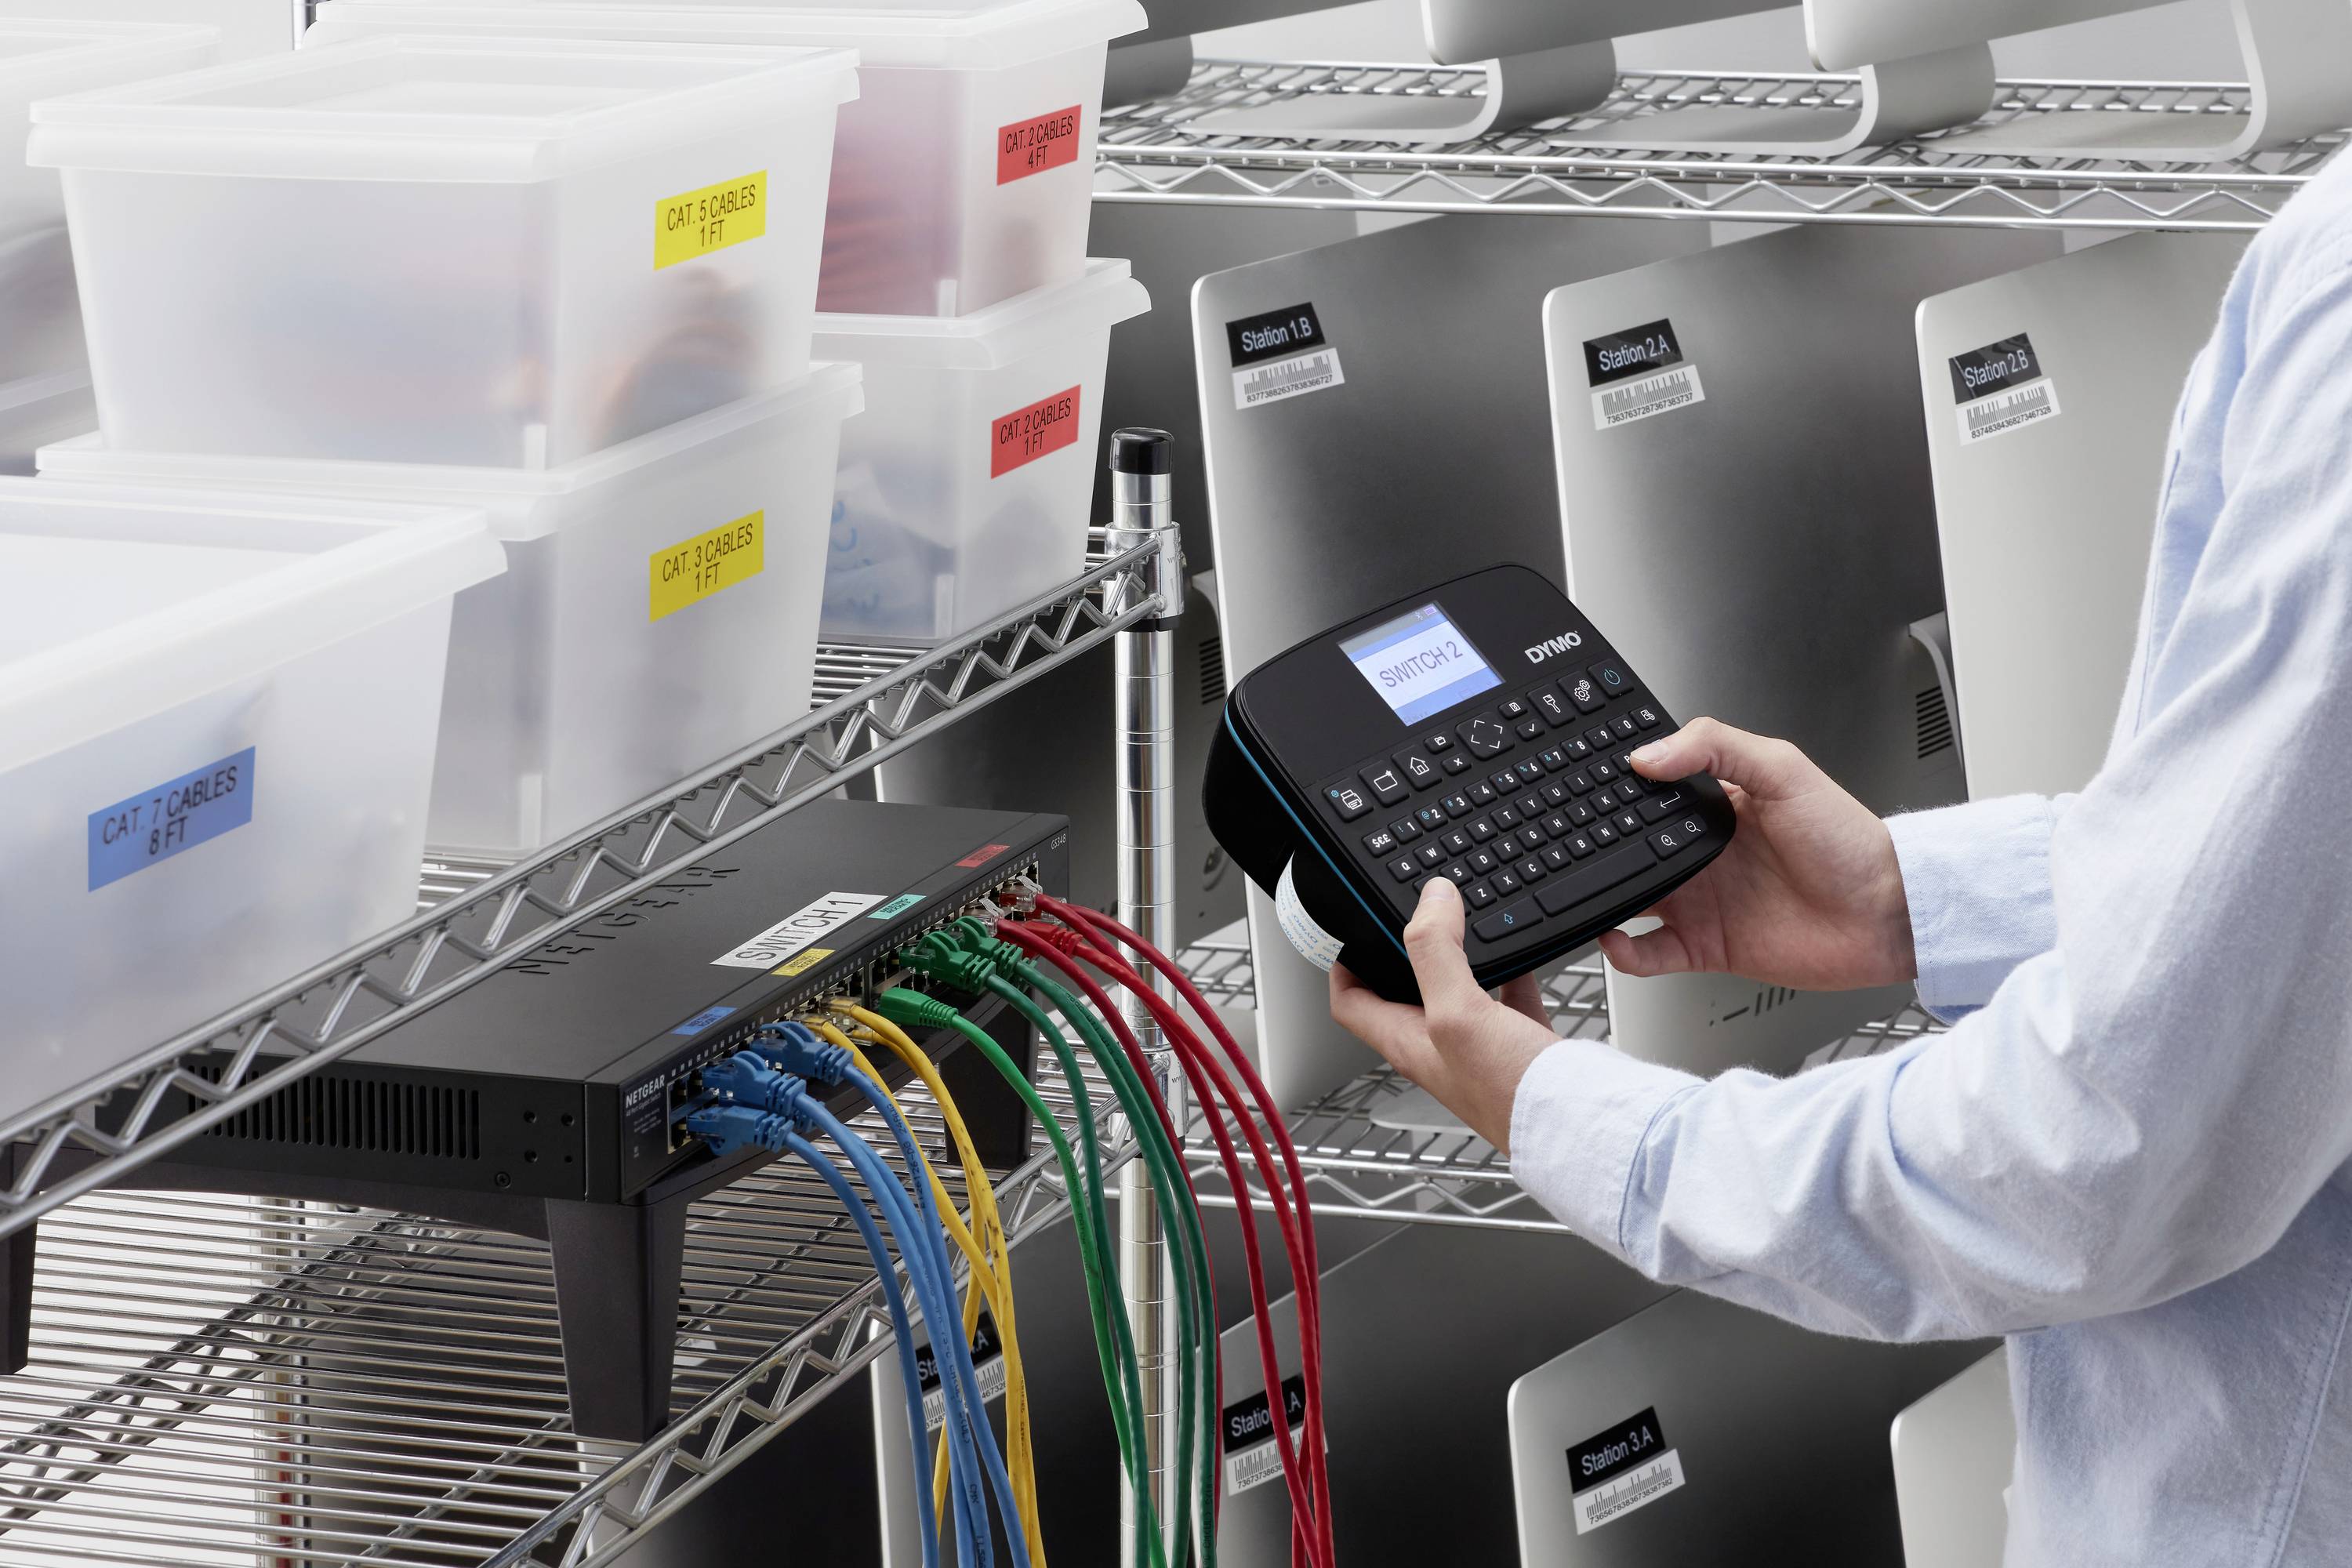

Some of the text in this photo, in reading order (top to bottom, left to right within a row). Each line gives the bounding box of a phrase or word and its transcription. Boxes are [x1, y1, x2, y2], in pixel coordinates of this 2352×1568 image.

[1006, 115, 1073, 154] CAT. 2 CABLES
[1028, 145, 1048, 169] 4 FT
[667, 184, 756, 231] CAT. 5 CABLES
[700, 220, 725, 247] 1 FT
[1242, 317, 1312, 352] Station 1.B
[1599, 334, 1670, 372] Station 2.A
[1965, 349, 2029, 388] Station 2.B
[1000, 397, 1072, 445] CAT. 2 CABLES
[1025, 430, 1045, 456] 1 FT
[662, 523, 753, 582] CAT. 3 CABLES
[695, 562, 720, 593] 1 FT
[1379, 641, 1464, 688] SWITCH 2
[1524, 632, 1582, 664] DYMO
[1407, 822, 1416, 831] 1
[1421, 811, 1430, 820] @
[1431, 809, 1441, 819] 2
[1456, 797, 1465, 807] 3
[1481, 785, 1490, 795] 4
[1504, 773, 1515, 783] 5
[1530, 763, 1538, 772] 6
[1552, 751, 1561, 760] 7
[1577, 741, 1586, 750] 8
[1600, 730, 1608, 739] 9
[103, 765, 238, 845] CAT. 7 CABLES
[148, 816, 188, 856] 8 FT
[1401, 862, 1411, 871] Q
[1426, 848, 1437, 858] W
[1453, 835, 1463, 845] E
[1478, 823, 1488, 833] R
[1502, 811, 1512, 820] T
[1527, 799, 1536, 808] Y
[1552, 787, 1561, 797] U
[1454, 786, 1634, 877] S D F G H J K L
[1477, 815, 1635, 898] Z X C V B N M
[735, 909, 848, 960] SWITCH
[626, 1074, 666, 1109] NETGEAR
[1231, 1406, 1272, 1437] Statio
[1288, 1392, 1302, 1414] .A
[1581, 1425, 1654, 1475] Station 3.A
